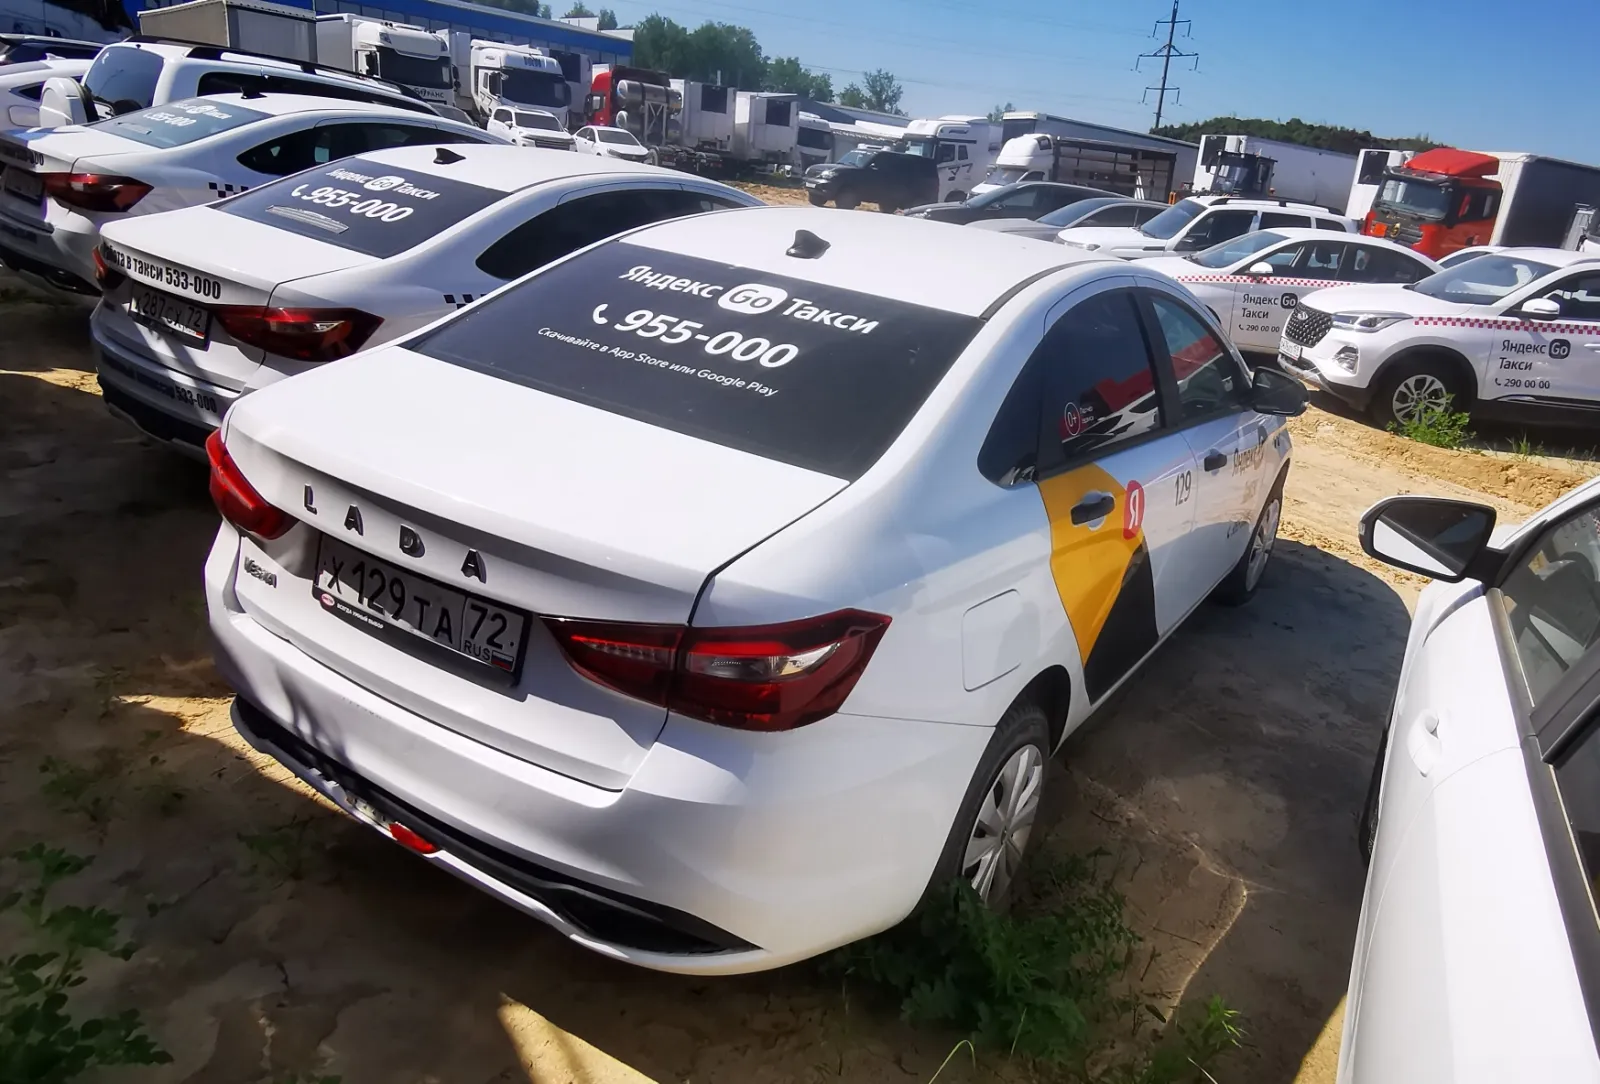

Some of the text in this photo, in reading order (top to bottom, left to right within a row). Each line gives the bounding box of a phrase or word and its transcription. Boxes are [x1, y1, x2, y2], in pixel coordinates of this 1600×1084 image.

[301, 186, 414, 222] 955-000
[393, 182, 441, 200] Такси
[133, 258, 163, 281] такси
[166, 267, 221, 299] 533-000
[618, 265, 880, 334] Яндекс Go Такси
[1241, 307, 1270, 319] Такси
[1243, 293, 1297, 307] Яндекс Go
[614, 307, 800, 369] 955-000
[1246, 324, 1260, 332] 290
[537, 326, 779, 398] Скачивайте в App Store или Google Play
[1499, 357, 1533, 371] Такси
[1501, 339, 1569, 356] Яндекс Go
[1504, 378, 1551, 390] 290 00 00
[1174, 470, 1192, 507] 129
[1128, 488, 1140, 530] Я
[303, 483, 488, 585] LADA
[469, 603, 508, 650] 72
[463, 639, 491, 661] RUS
